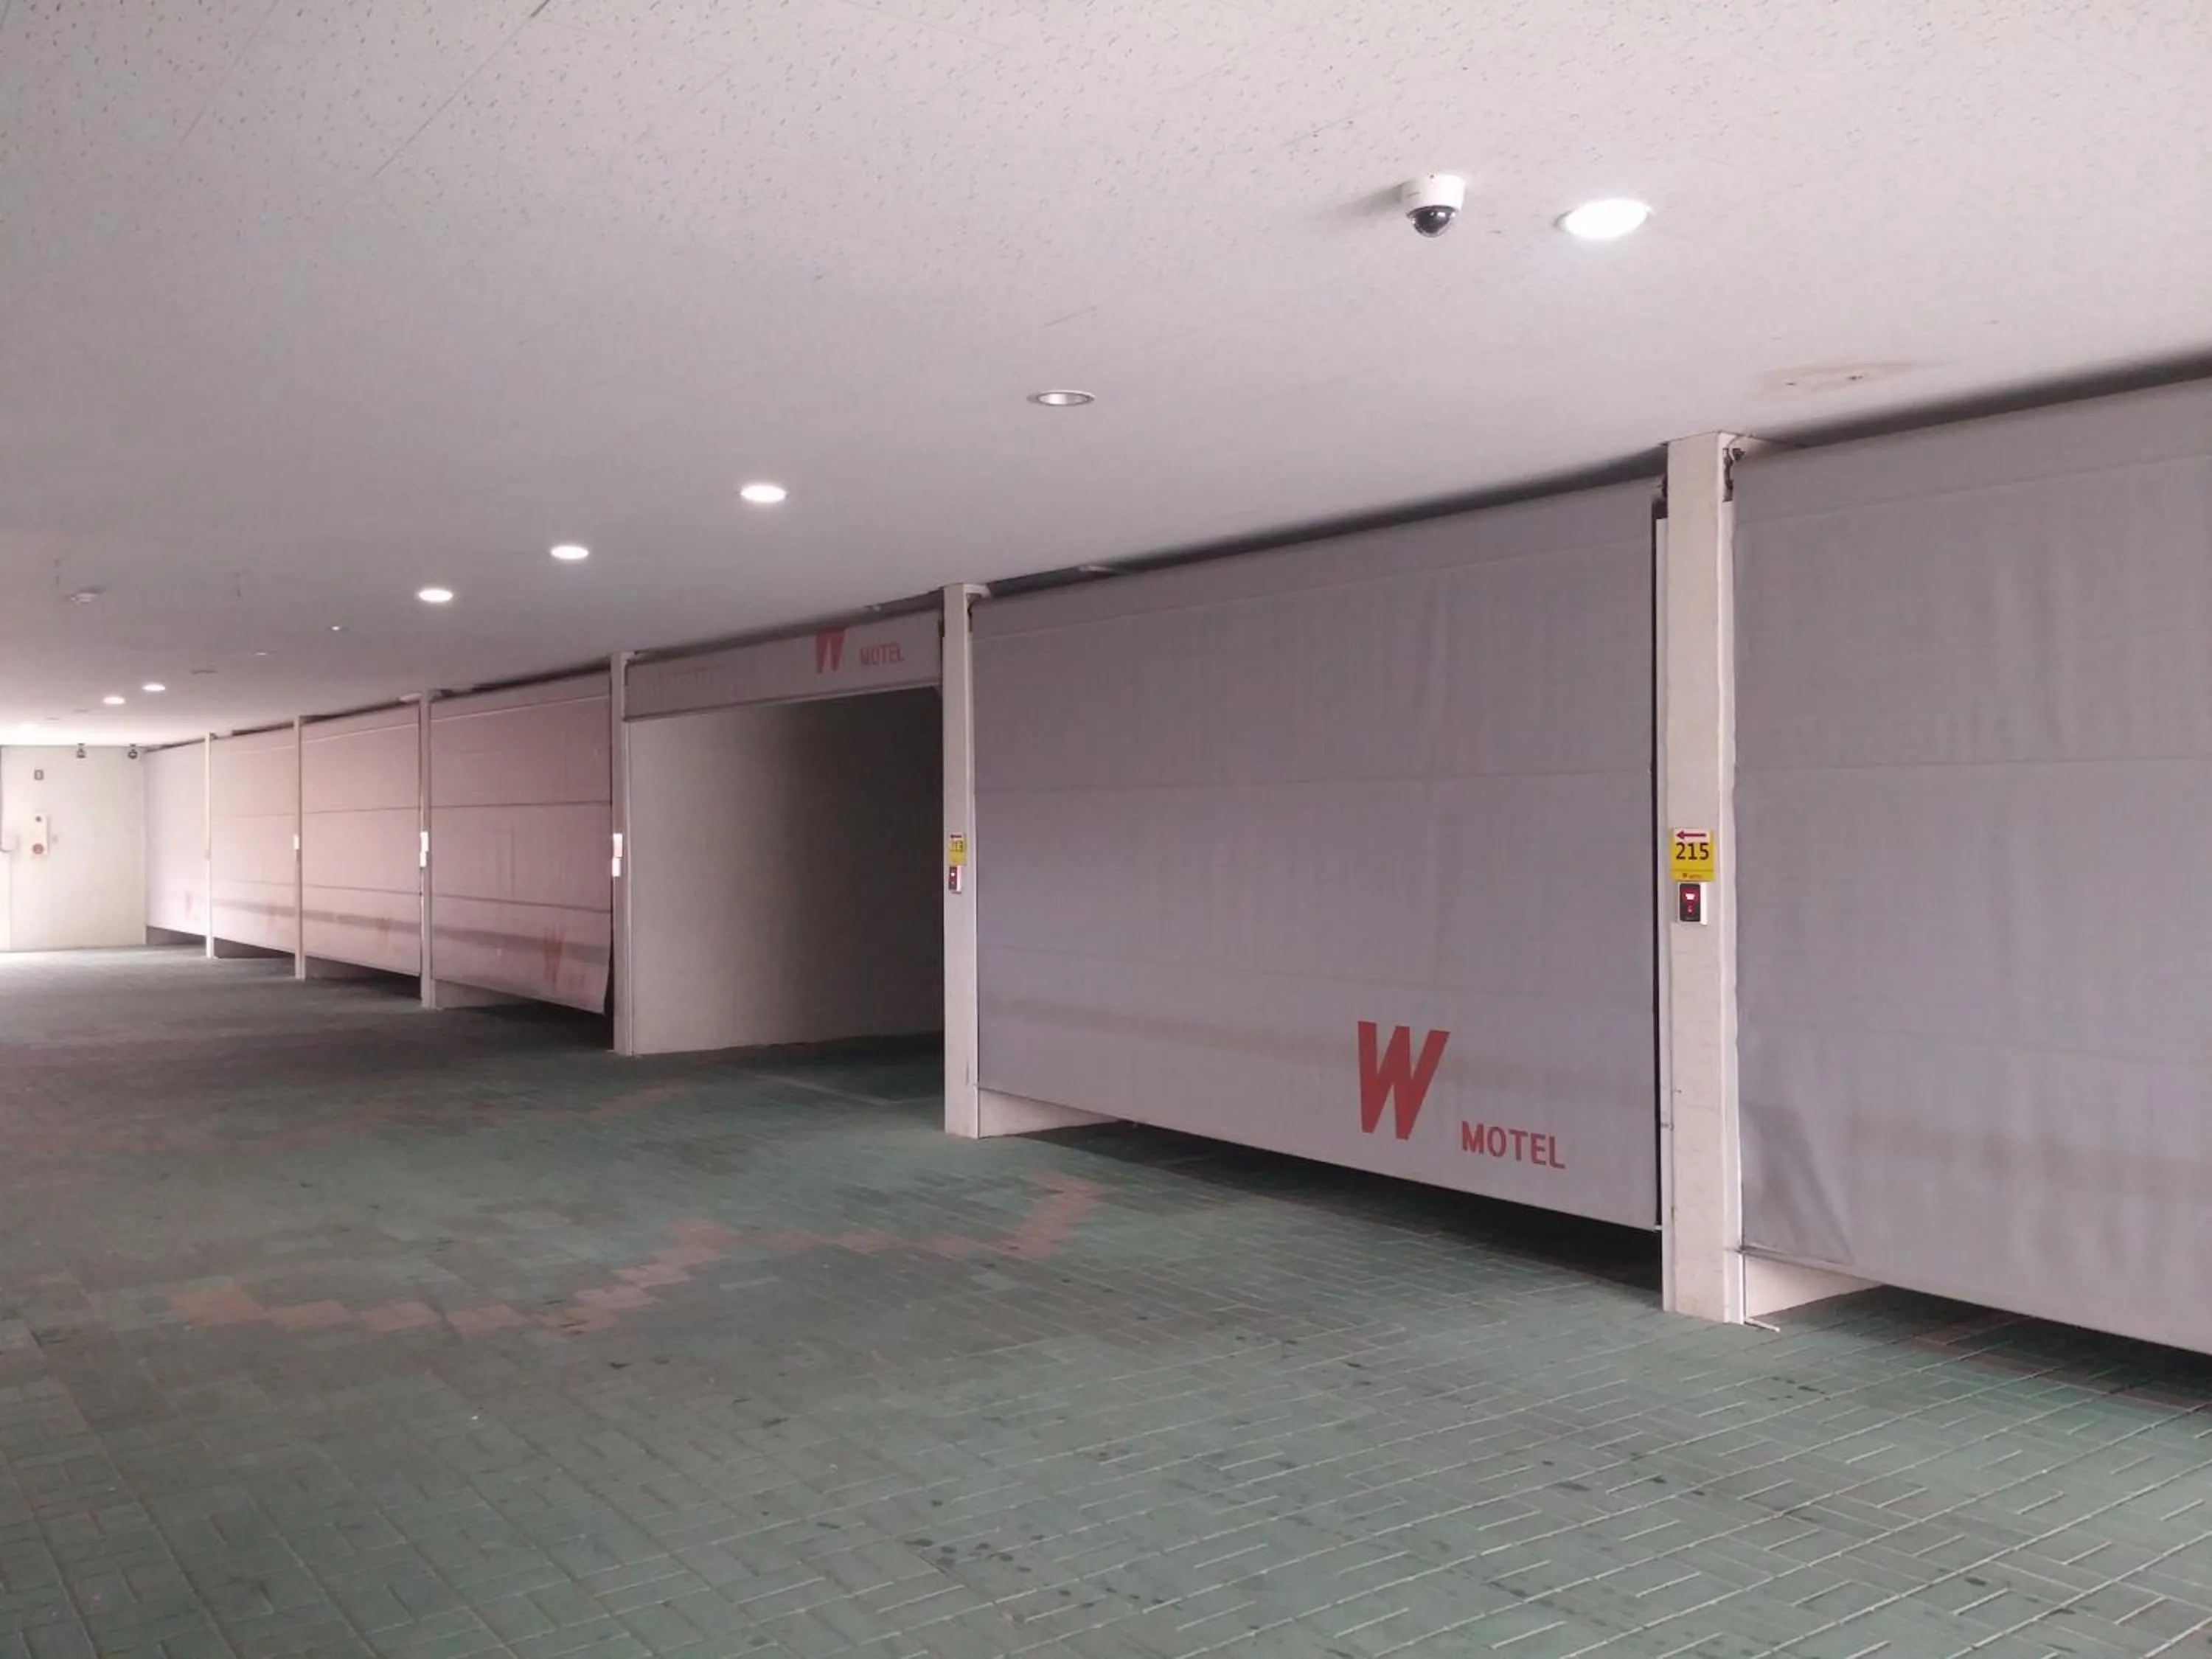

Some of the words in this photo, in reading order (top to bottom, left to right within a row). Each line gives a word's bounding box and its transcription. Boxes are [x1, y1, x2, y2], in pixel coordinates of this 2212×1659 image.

[815, 627, 846, 673] W
[860, 641, 905, 667] MOTEL
[1675, 842, 1709, 860] 215
[1357, 1020, 1451, 1141] W
[1461, 1120, 1565, 1169] MOTEL
